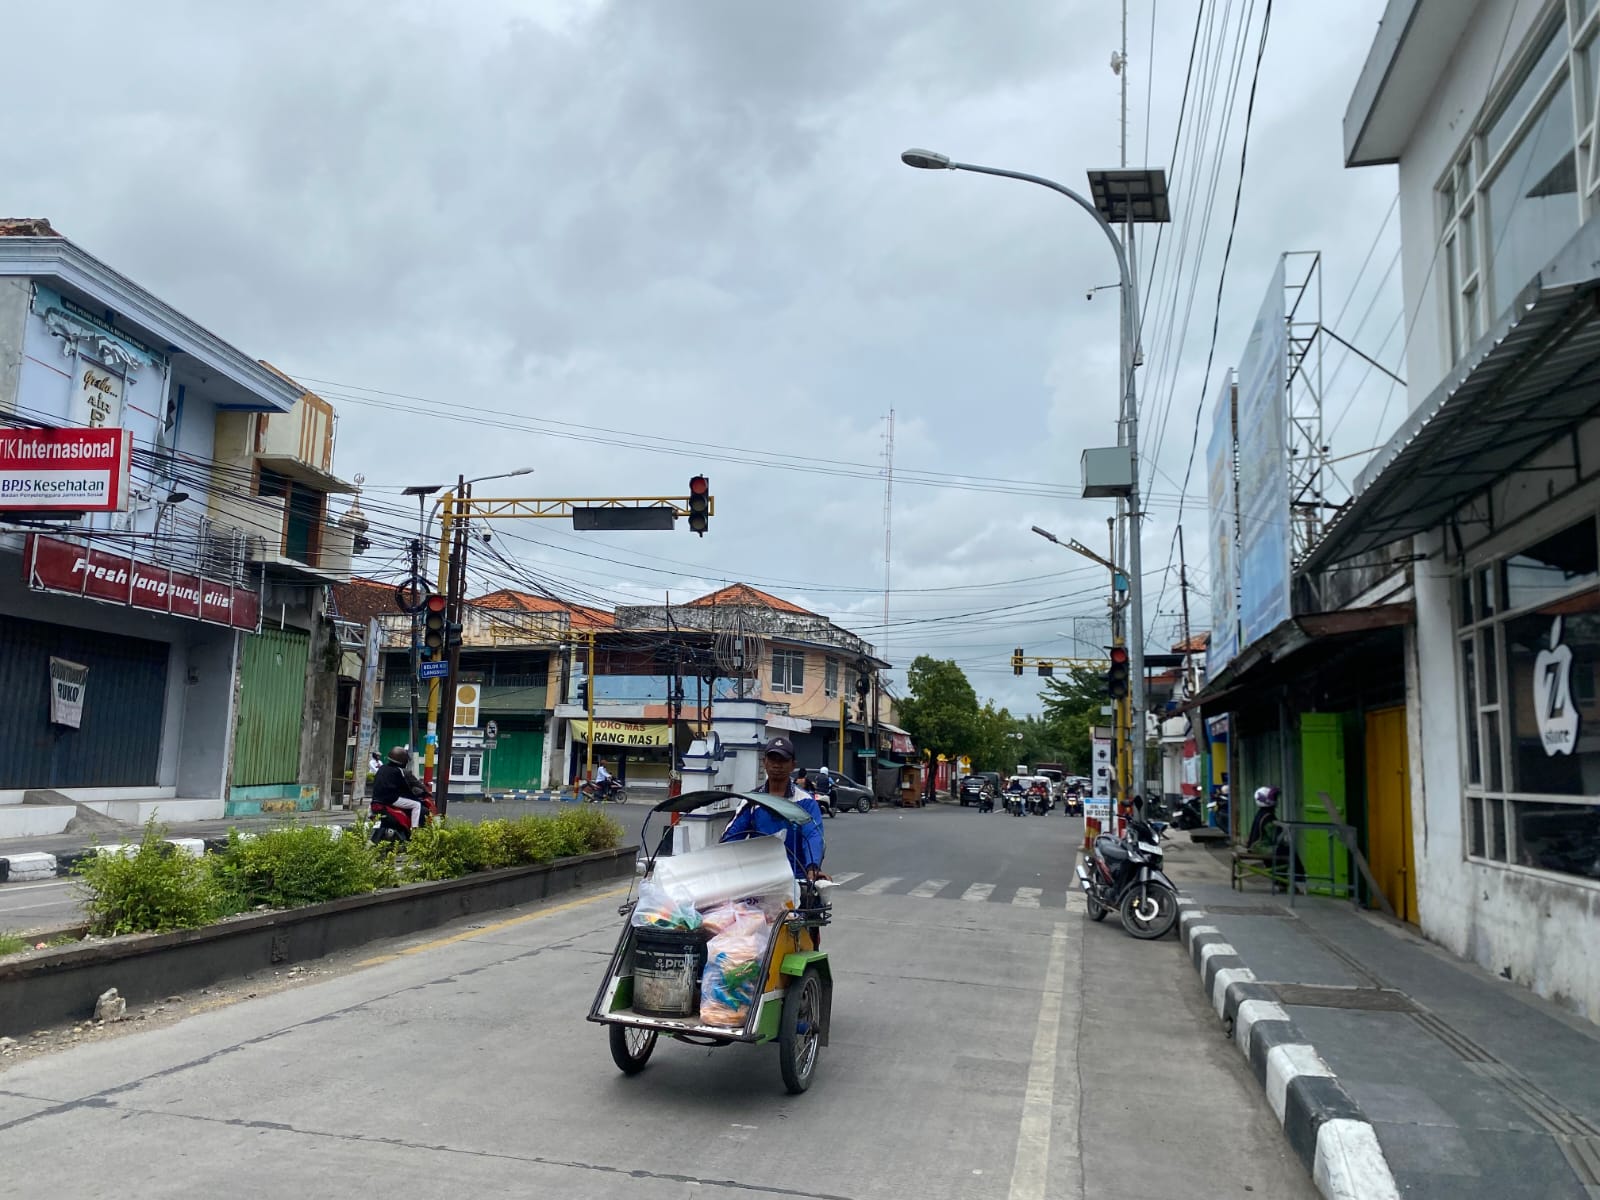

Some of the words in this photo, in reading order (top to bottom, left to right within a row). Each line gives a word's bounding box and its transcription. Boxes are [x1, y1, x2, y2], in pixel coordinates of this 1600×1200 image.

[17, 437, 115, 459] Internasional
[2, 479, 32, 492] BPJS
[34, 479, 104, 492] Kesehatan
[72, 558, 127, 584] Fresh
[57, 681, 80, 703] RUKO
[594, 720, 622, 730] TOKO
[624, 723, 646, 732] MAS
[580, 731, 625, 744] KRANG
[628, 735, 653, 745] MAS
[1544, 730, 1570, 745] store
